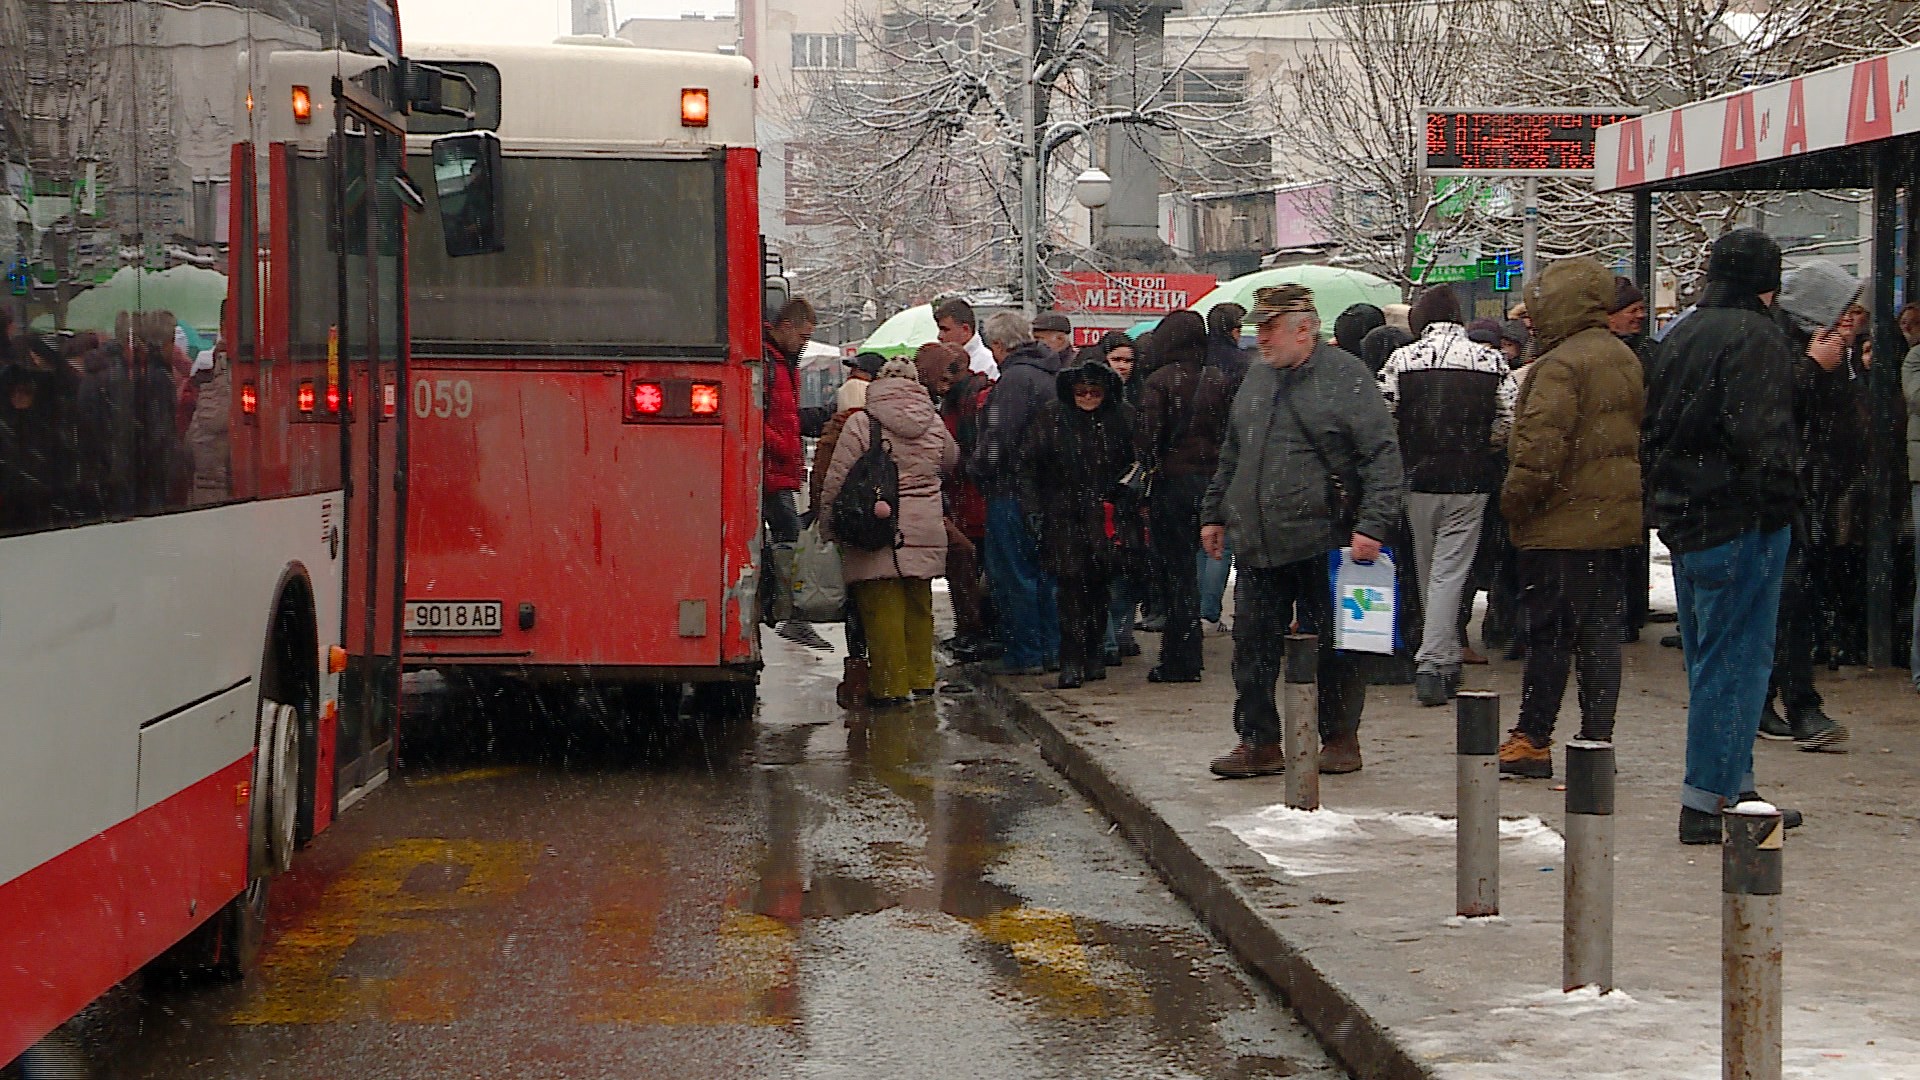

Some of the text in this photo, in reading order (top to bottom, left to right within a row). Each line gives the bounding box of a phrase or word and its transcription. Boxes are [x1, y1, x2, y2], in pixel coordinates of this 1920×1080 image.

[1138, 277, 1165, 289] ТОП
[1085, 289, 1188, 311] МЕКИЦИ
[414, 379, 472, 418] 059
[416, 606, 496, 626] 9018 AB
